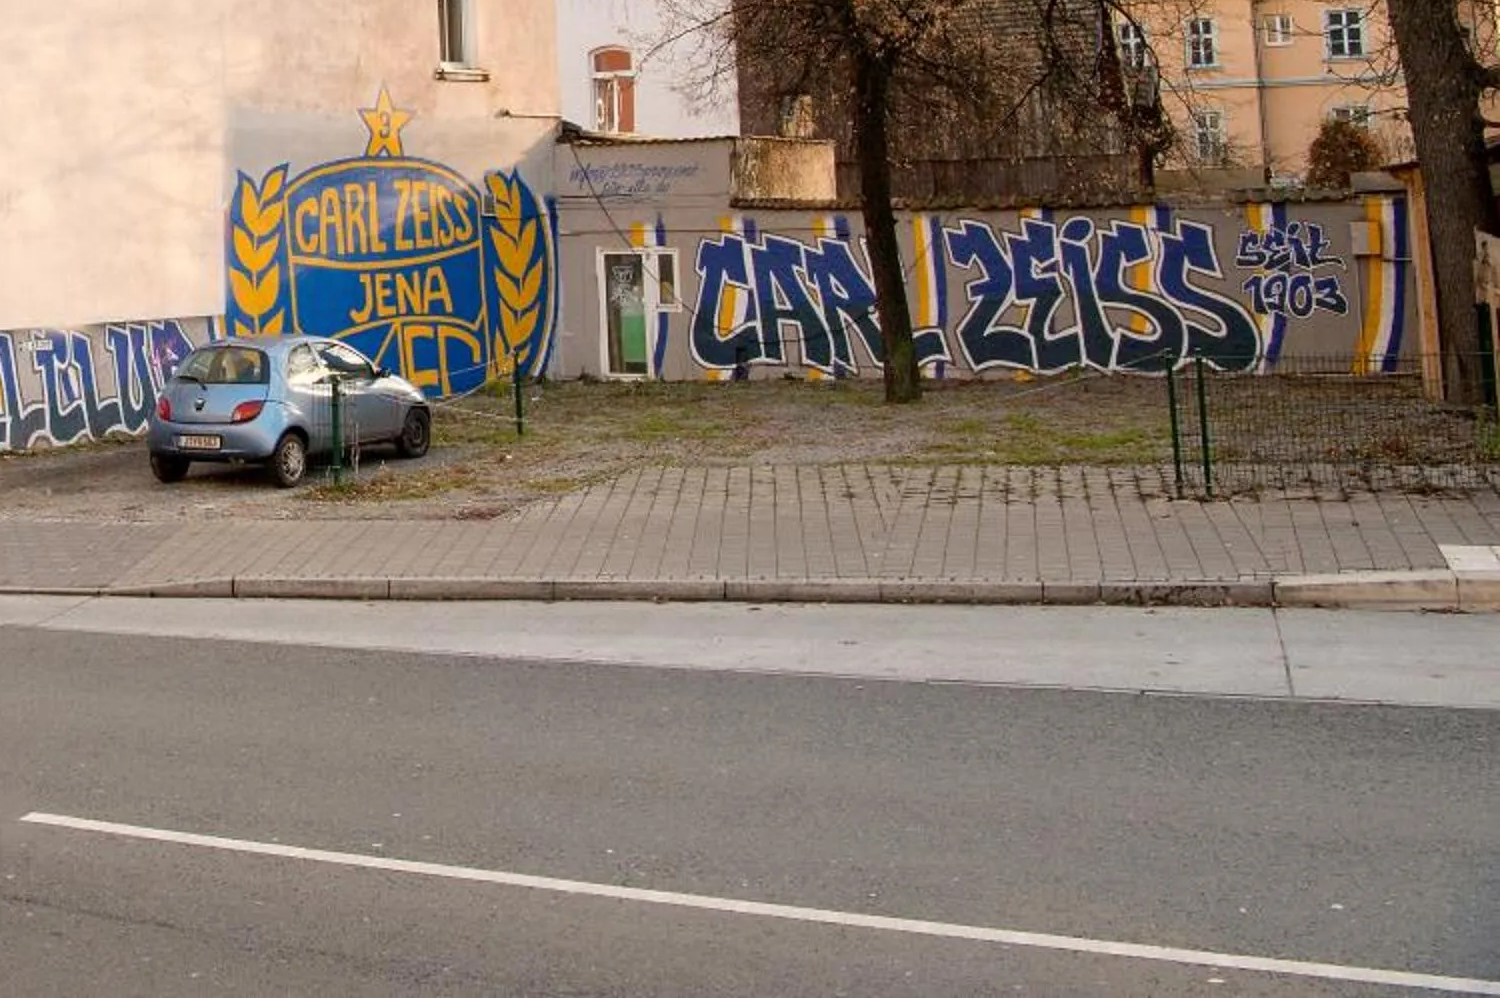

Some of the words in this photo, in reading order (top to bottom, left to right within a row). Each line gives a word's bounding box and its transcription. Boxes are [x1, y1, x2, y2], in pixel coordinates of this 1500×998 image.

[294, 181, 388, 256] CARL
[394, 178, 474, 251] ZEISS
[348, 265, 454, 325] JENA
[1242, 272, 1348, 318] 1903
